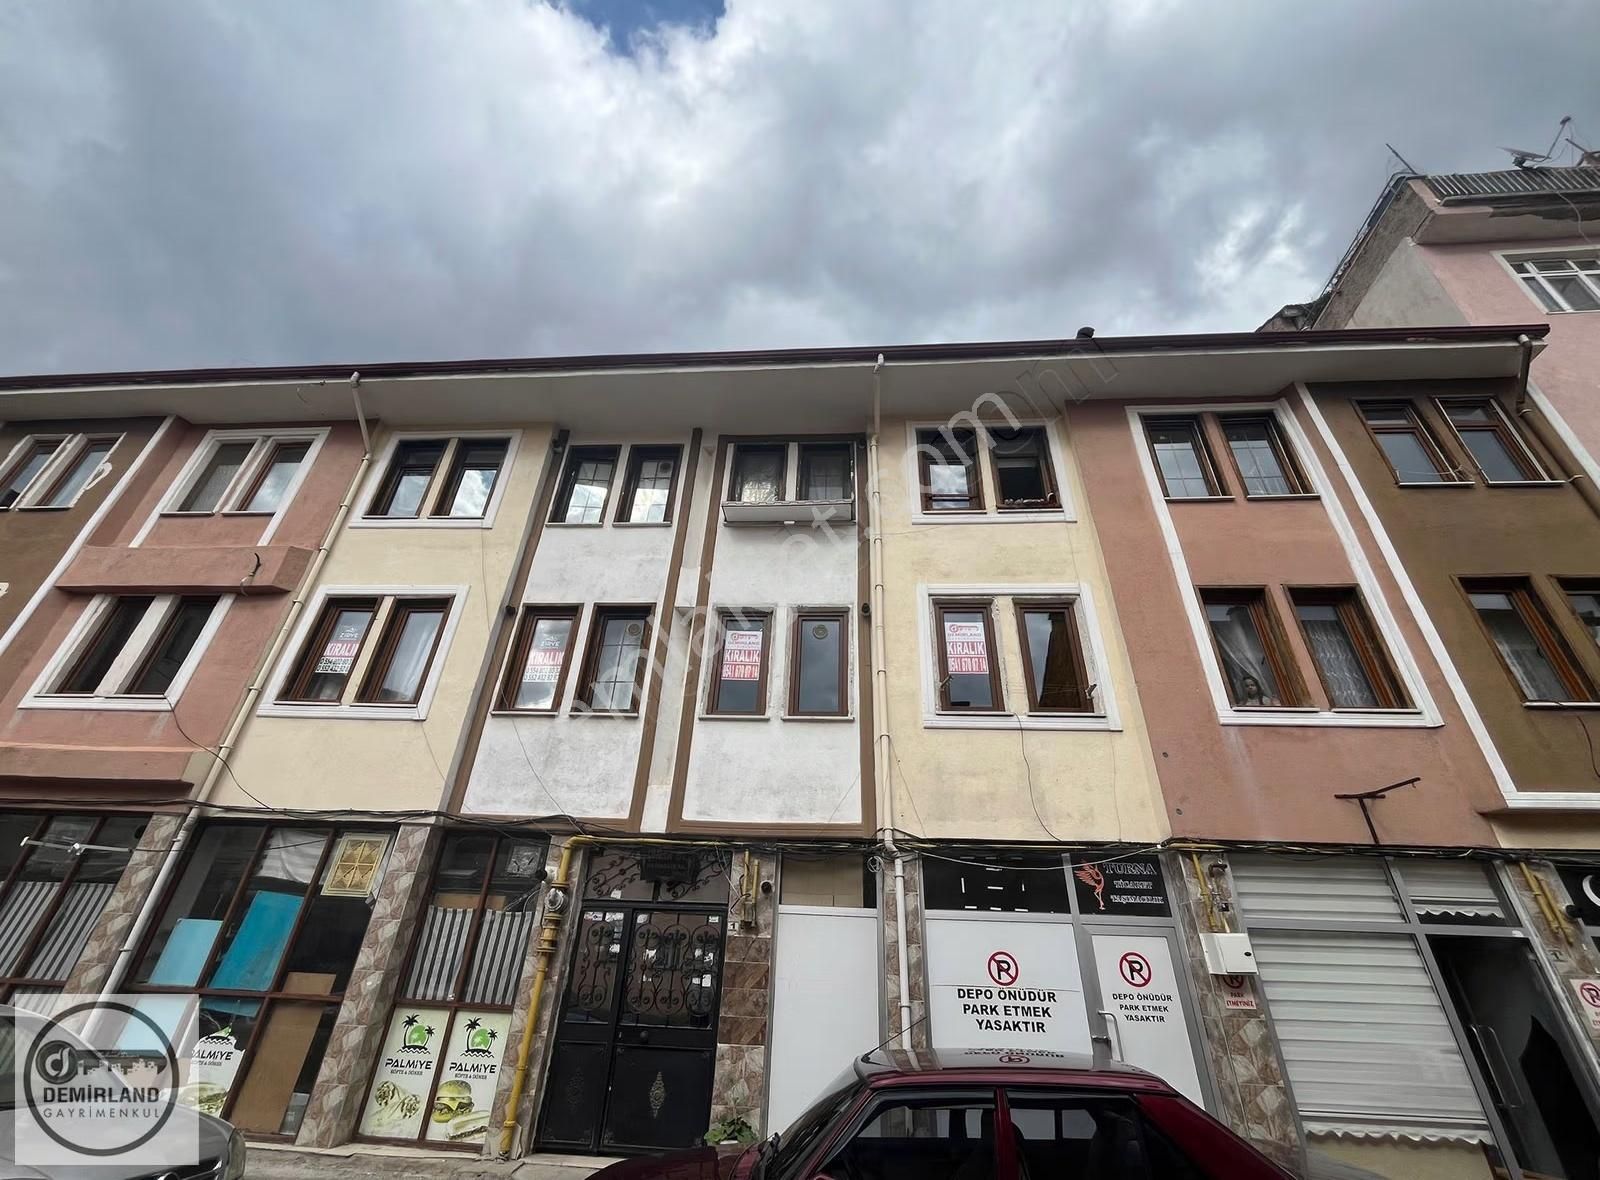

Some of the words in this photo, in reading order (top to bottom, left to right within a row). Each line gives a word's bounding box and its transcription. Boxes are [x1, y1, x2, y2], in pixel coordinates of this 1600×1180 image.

[323, 642, 360, 656] KİRALI
[1103, 861, 1157, 875] TURNA
[957, 988, 993, 1000] DEPO
[997, 987, 1057, 1003] ÖNÜDÜR
[1112, 993, 1135, 1001] DEPO
[1136, 992, 1173, 1002] ÖNÜDÜR
[963, 1003, 1000, 1016] PARK
[1003, 1005, 1052, 1018] ETMEK
[976, 1018, 1046, 1033] YASAKTIR
[1124, 1014, 1166, 1023] YASAKTIR
